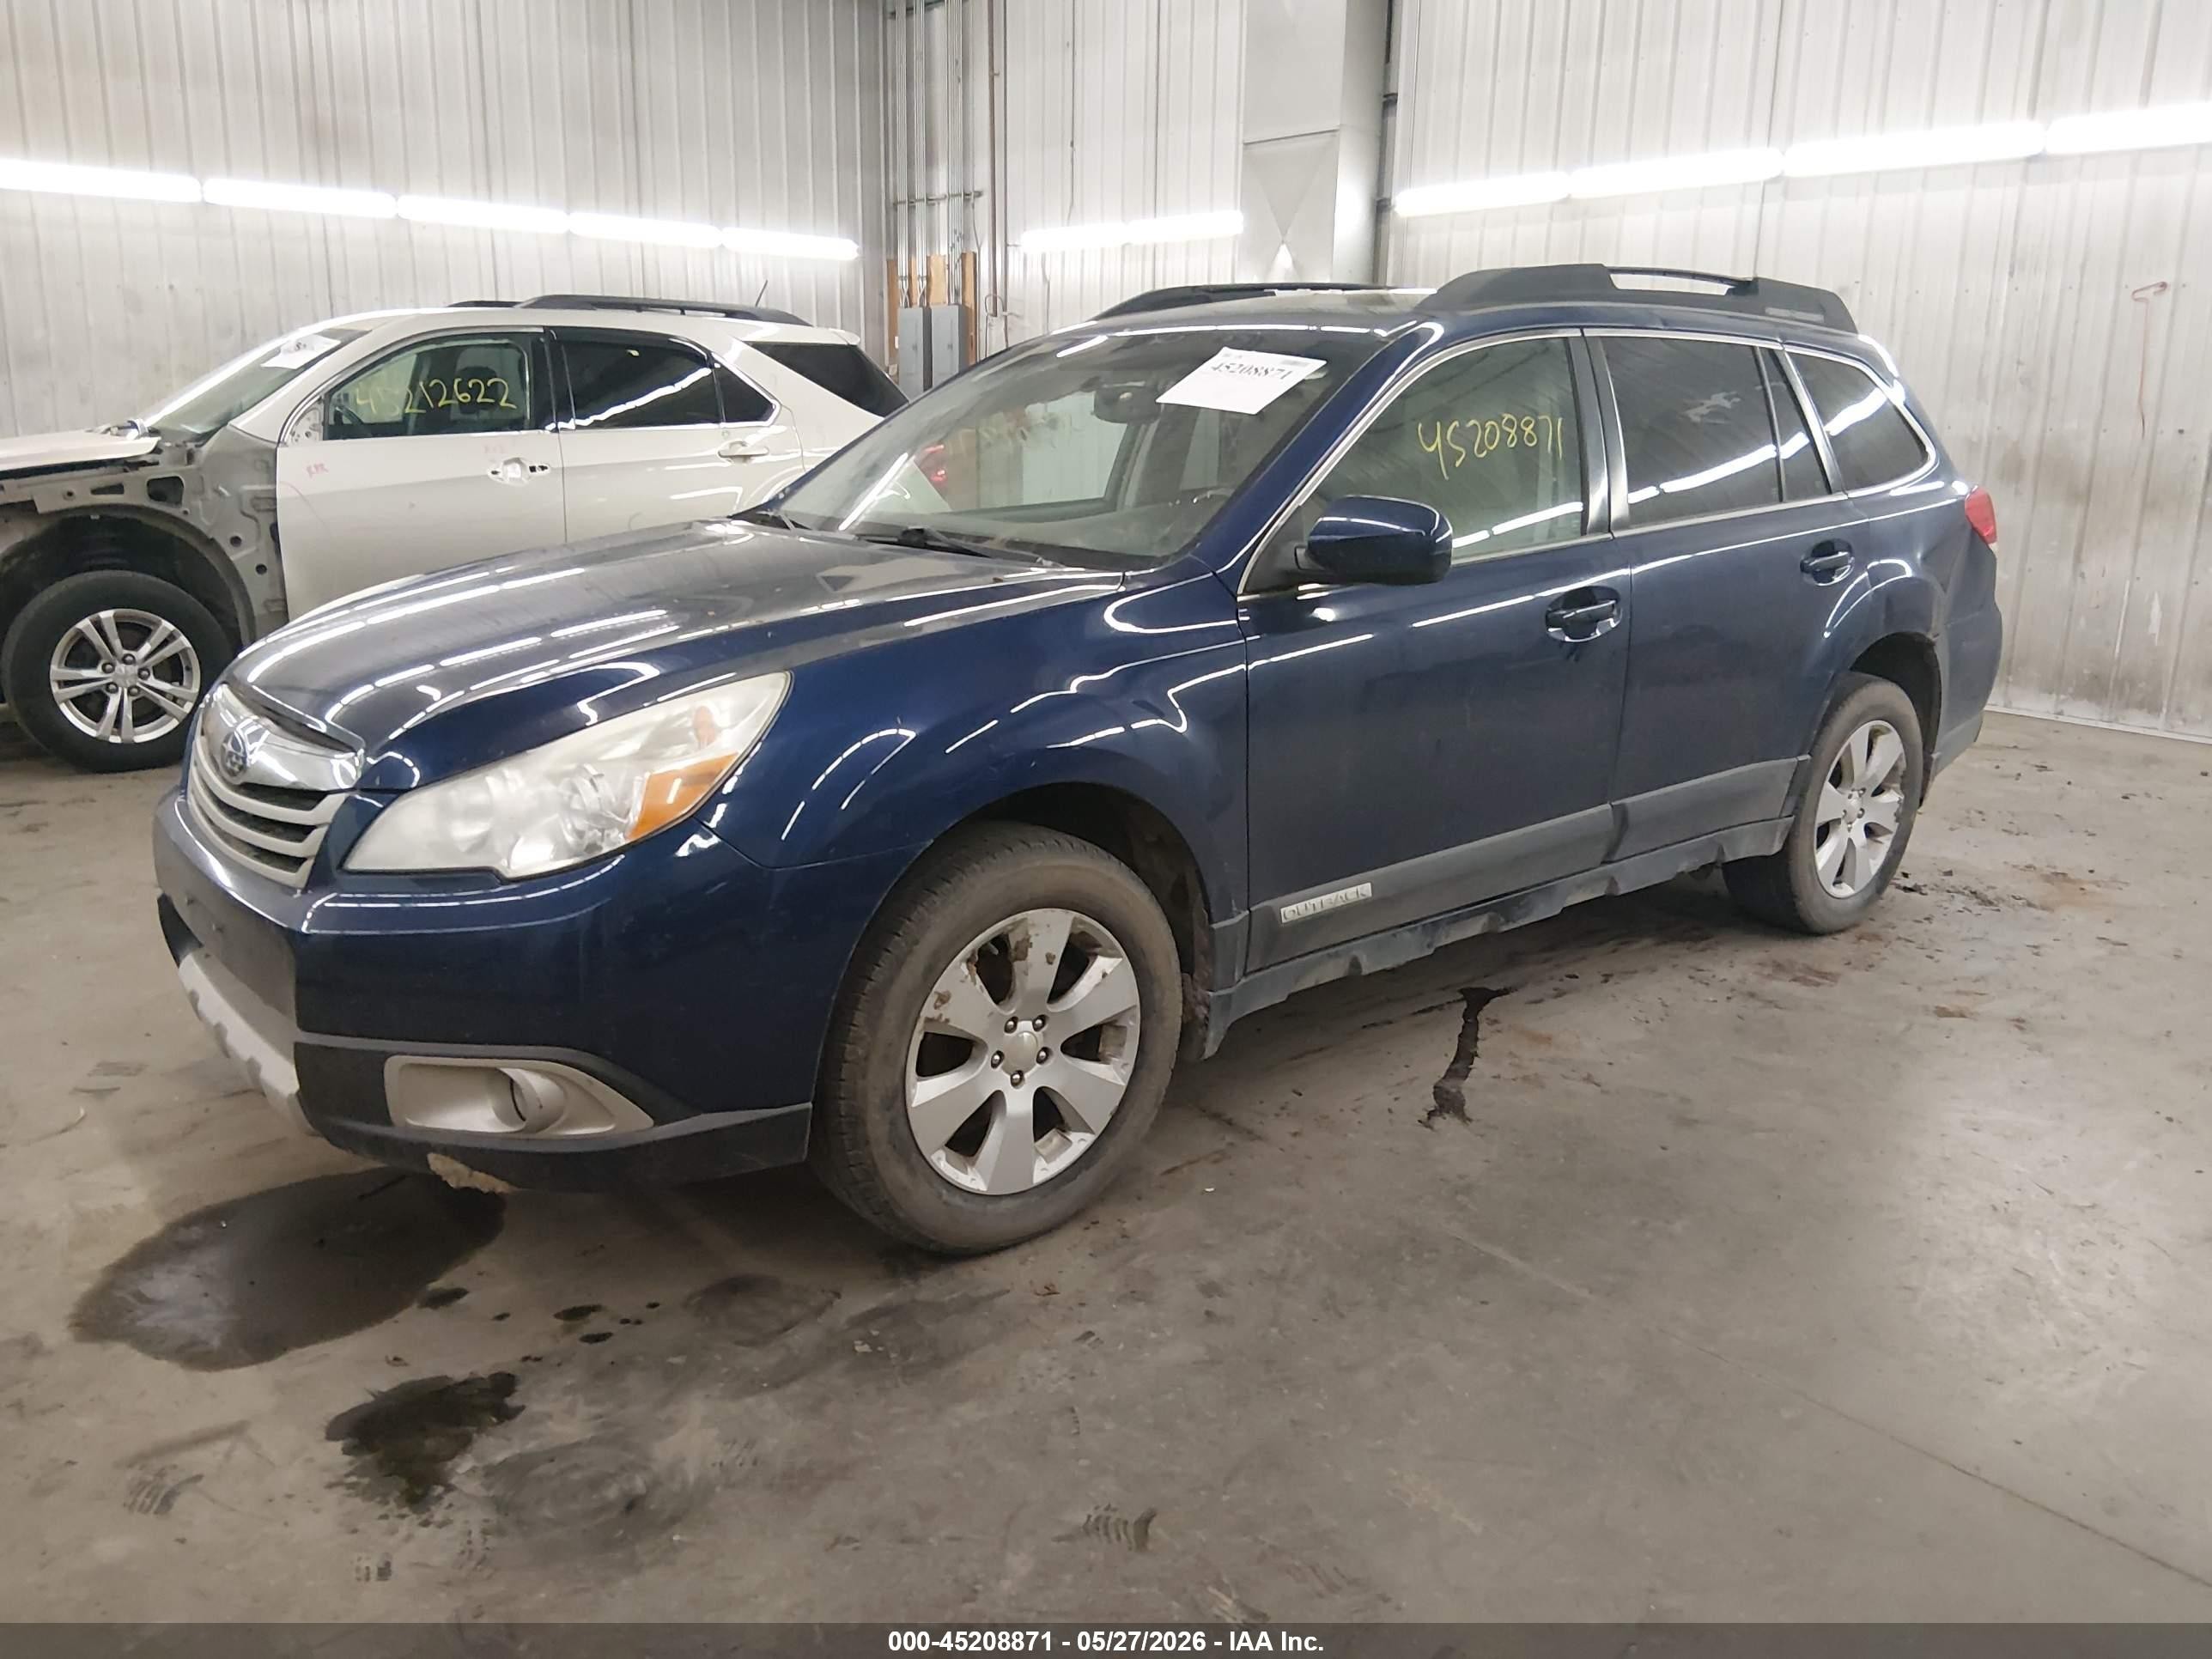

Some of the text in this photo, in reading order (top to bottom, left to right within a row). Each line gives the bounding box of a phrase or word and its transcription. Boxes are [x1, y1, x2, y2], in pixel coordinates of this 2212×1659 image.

[1212, 358, 1293, 380] 45208871
[356, 377, 517, 416] 45212622
[1418, 412, 1563, 481] 45208871
